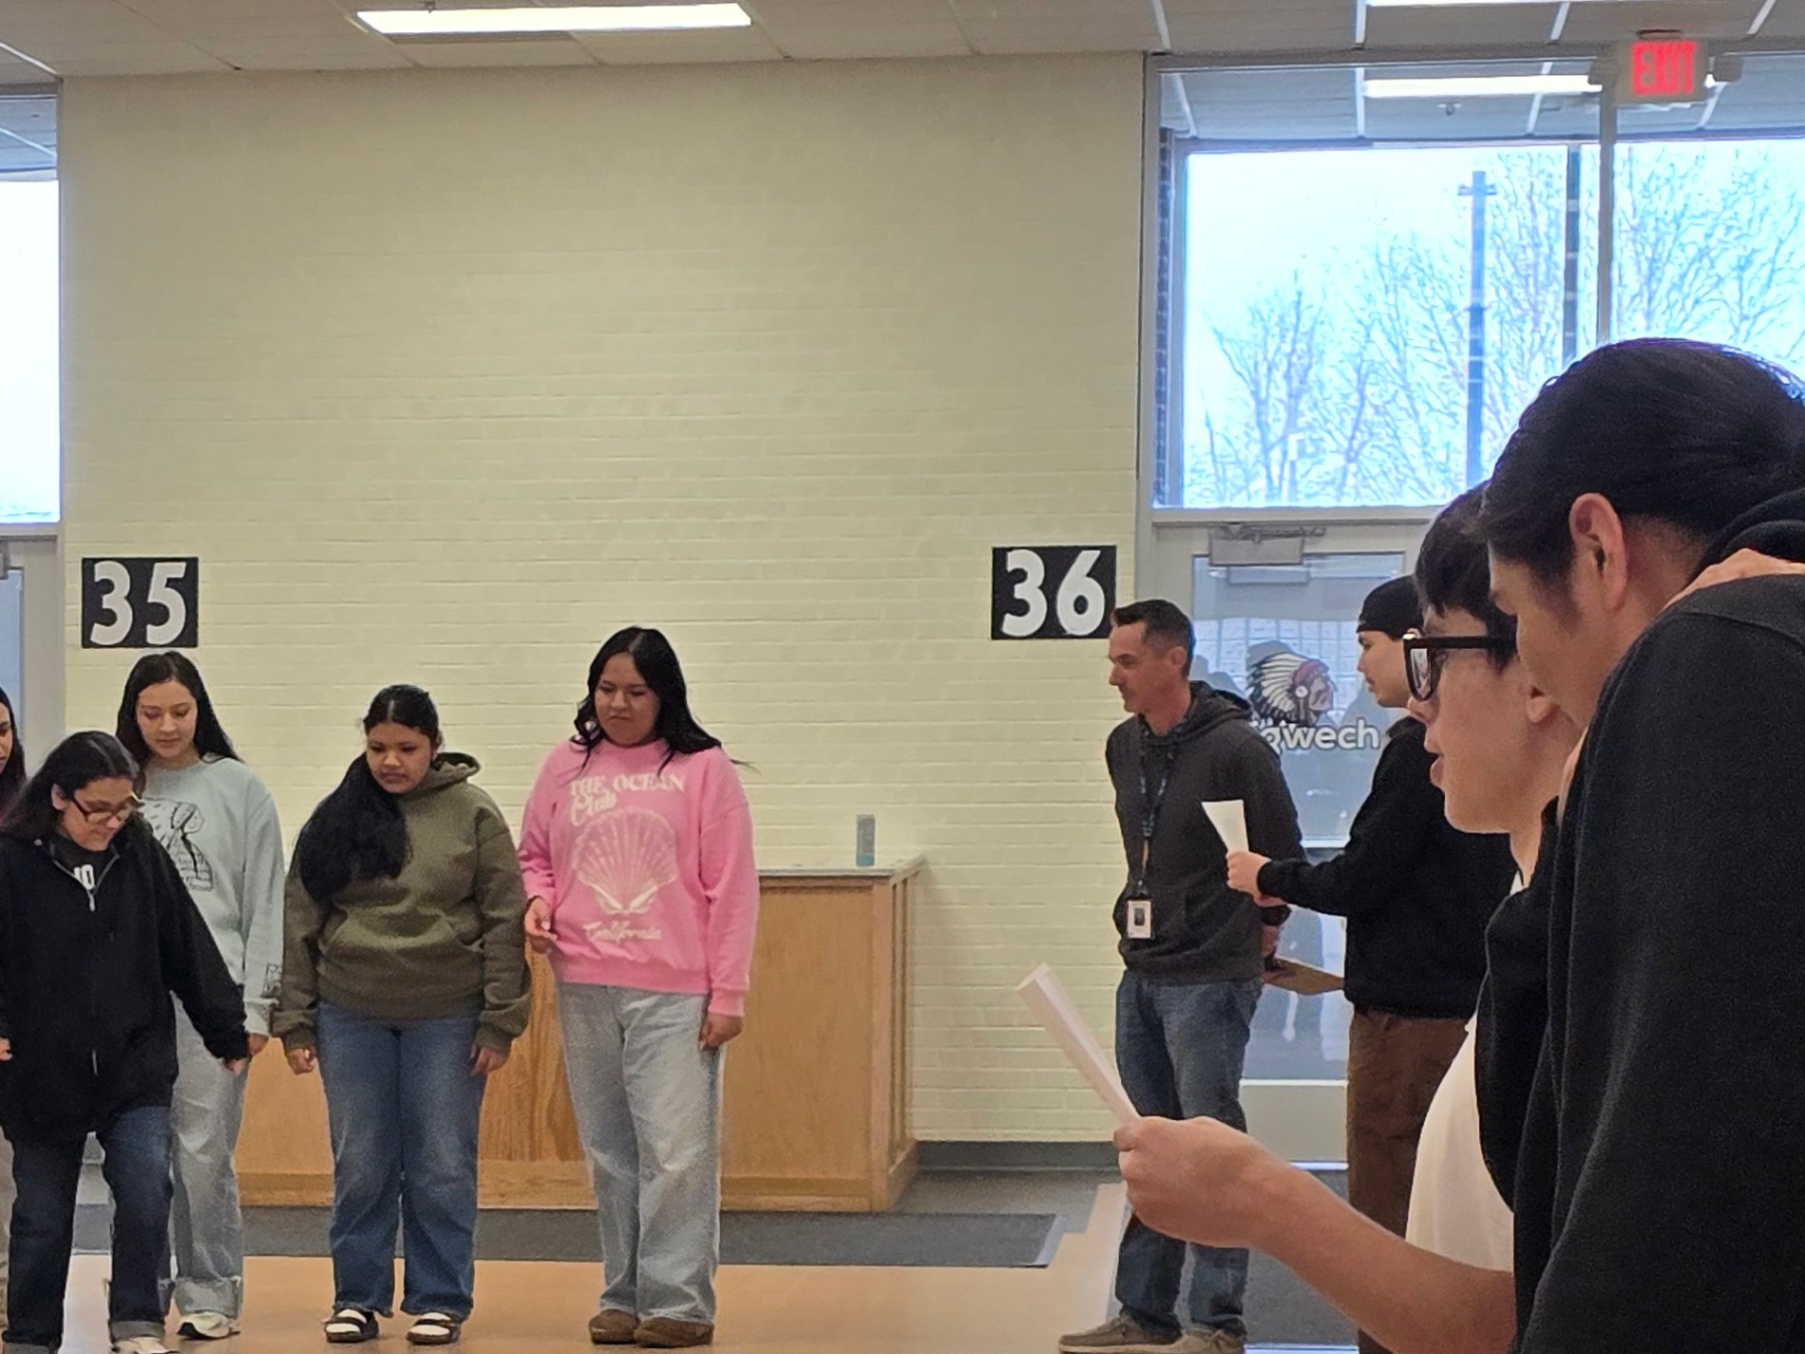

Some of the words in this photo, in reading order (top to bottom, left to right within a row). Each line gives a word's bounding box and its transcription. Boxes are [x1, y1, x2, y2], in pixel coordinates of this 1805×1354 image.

[1631, 41, 1698, 95] EXIT
[91, 560, 188, 646] 35
[1001, 549, 1106, 638] 36
[1257, 718, 1380, 756] gwech
